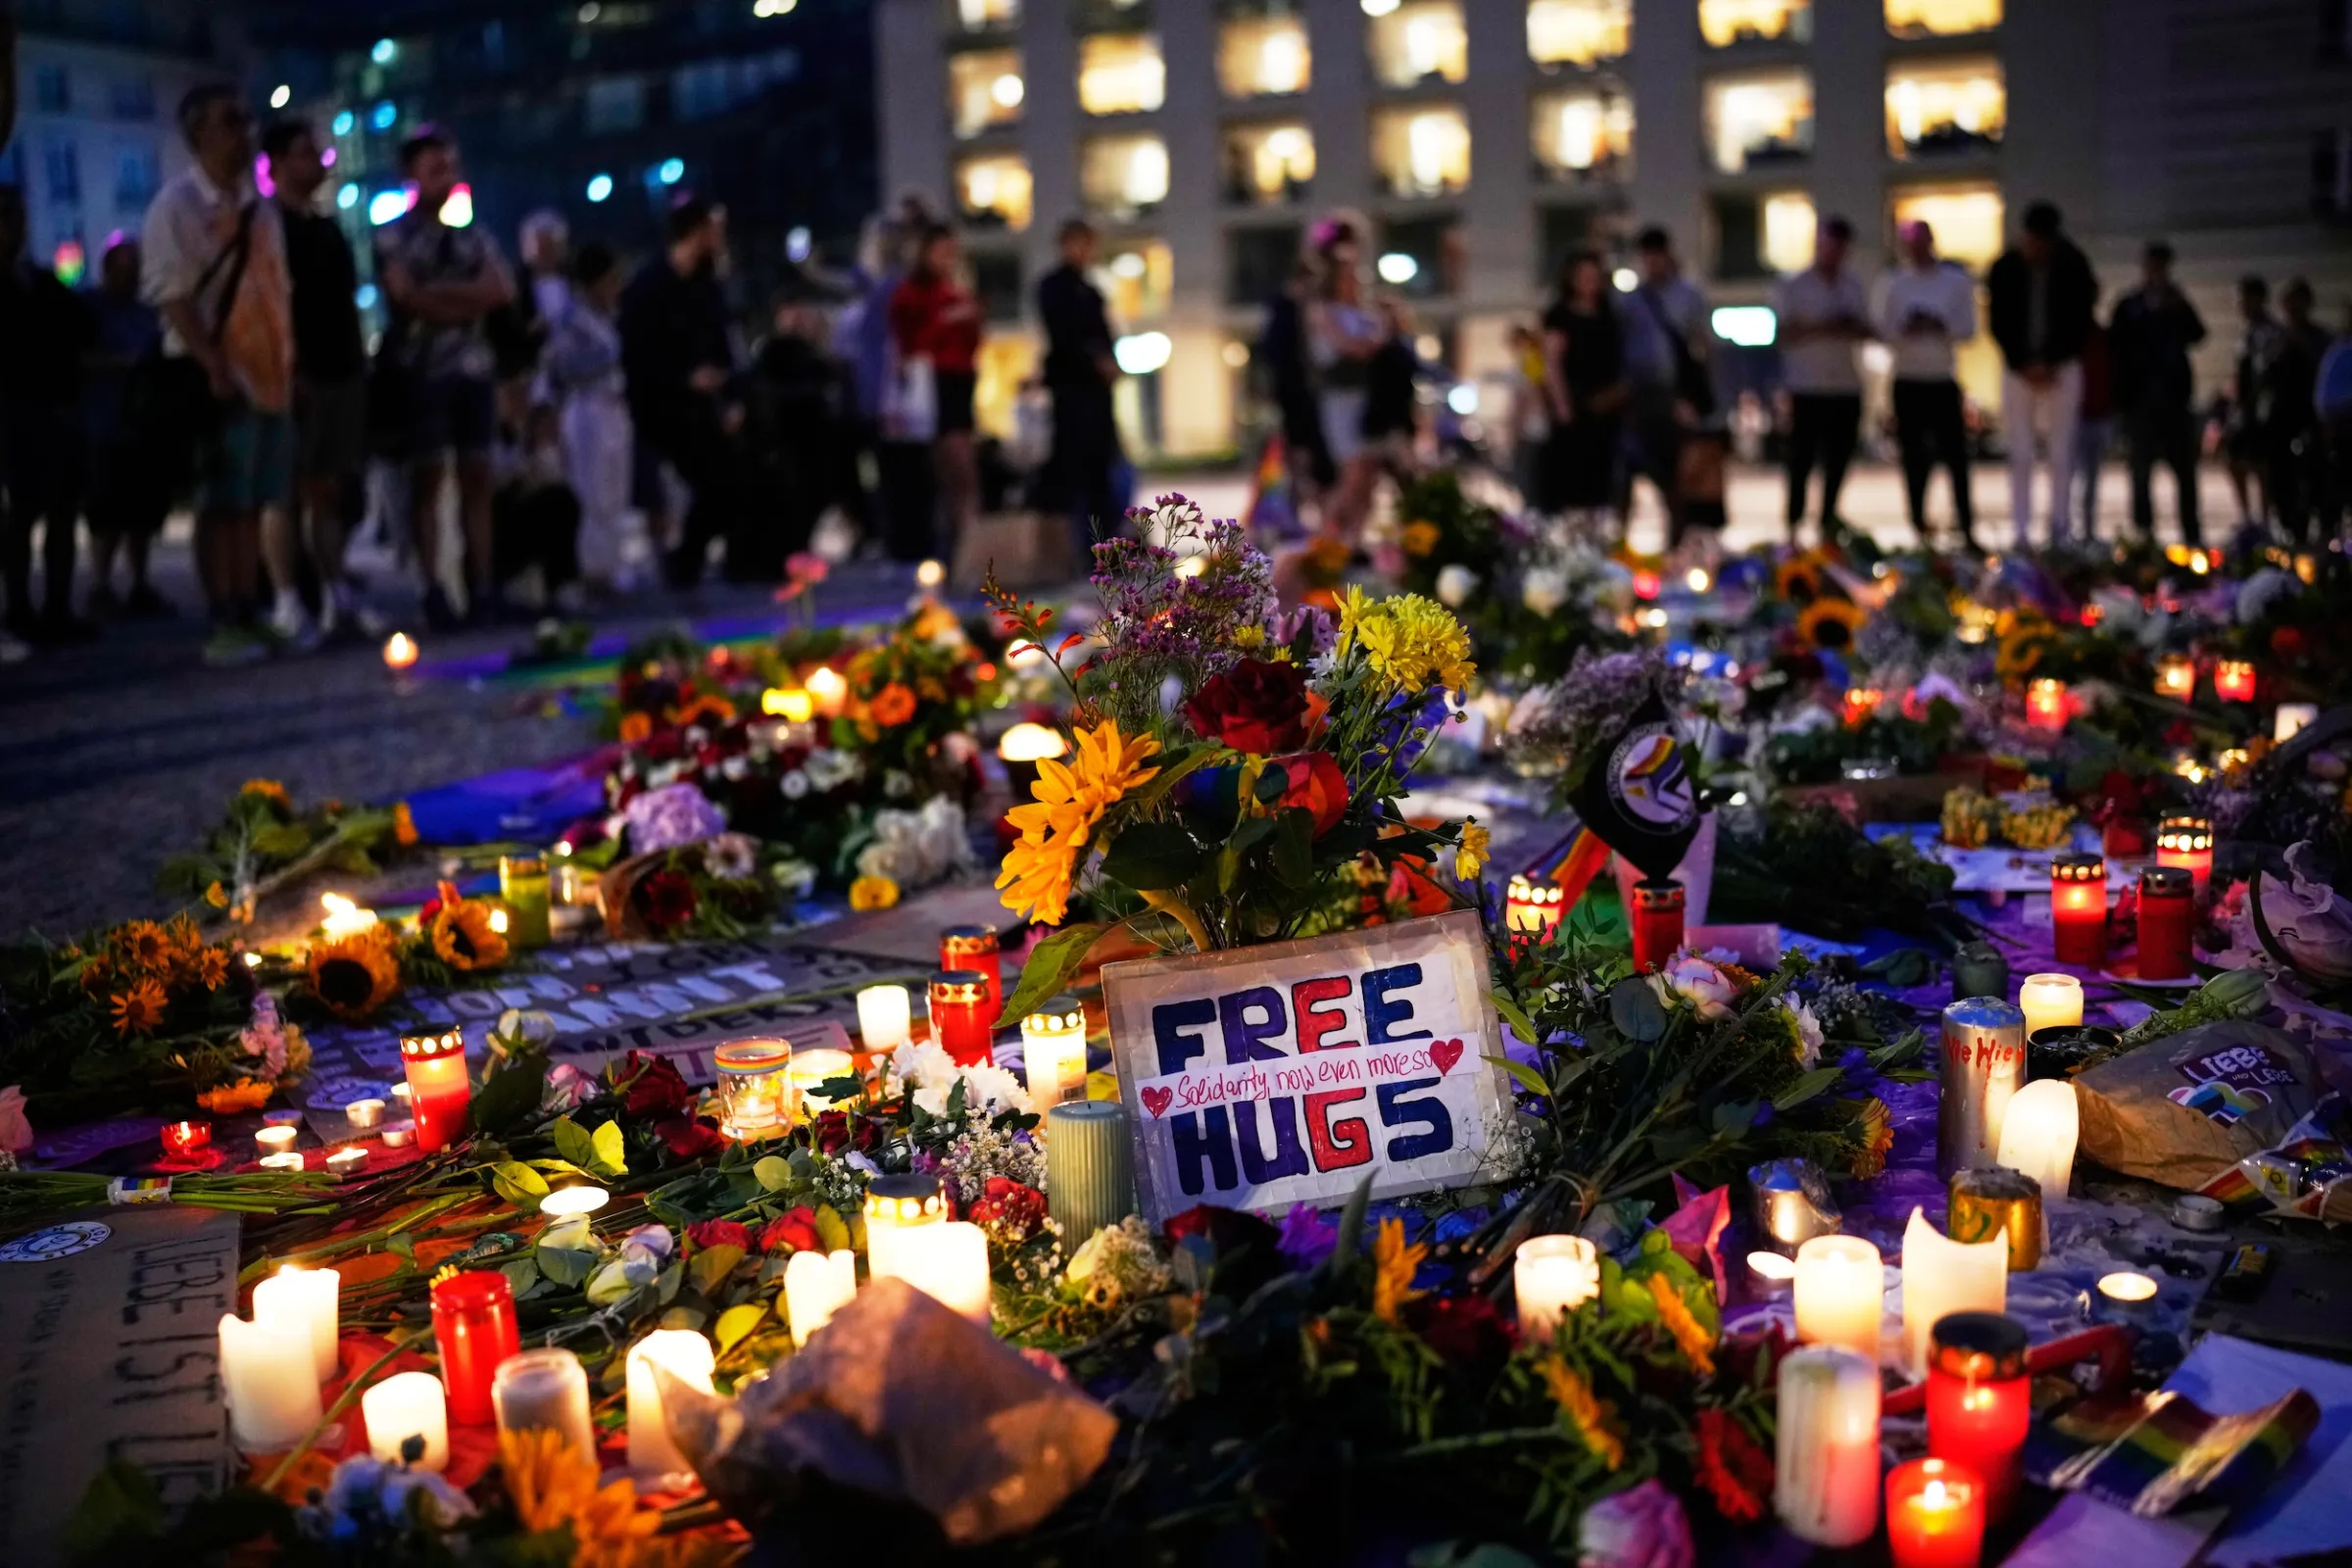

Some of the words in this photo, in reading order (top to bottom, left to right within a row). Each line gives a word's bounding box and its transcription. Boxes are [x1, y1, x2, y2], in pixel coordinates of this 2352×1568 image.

[1152, 962, 1433, 1076] FREE
[1276, 1061, 1315, 1093] now
[1319, 1057, 1361, 1084] even
[2182, 1046, 2271, 1084] LIEBE
[2231, 1072, 2249, 1082] UND
[1170, 1078, 1453, 1197] HUGS
